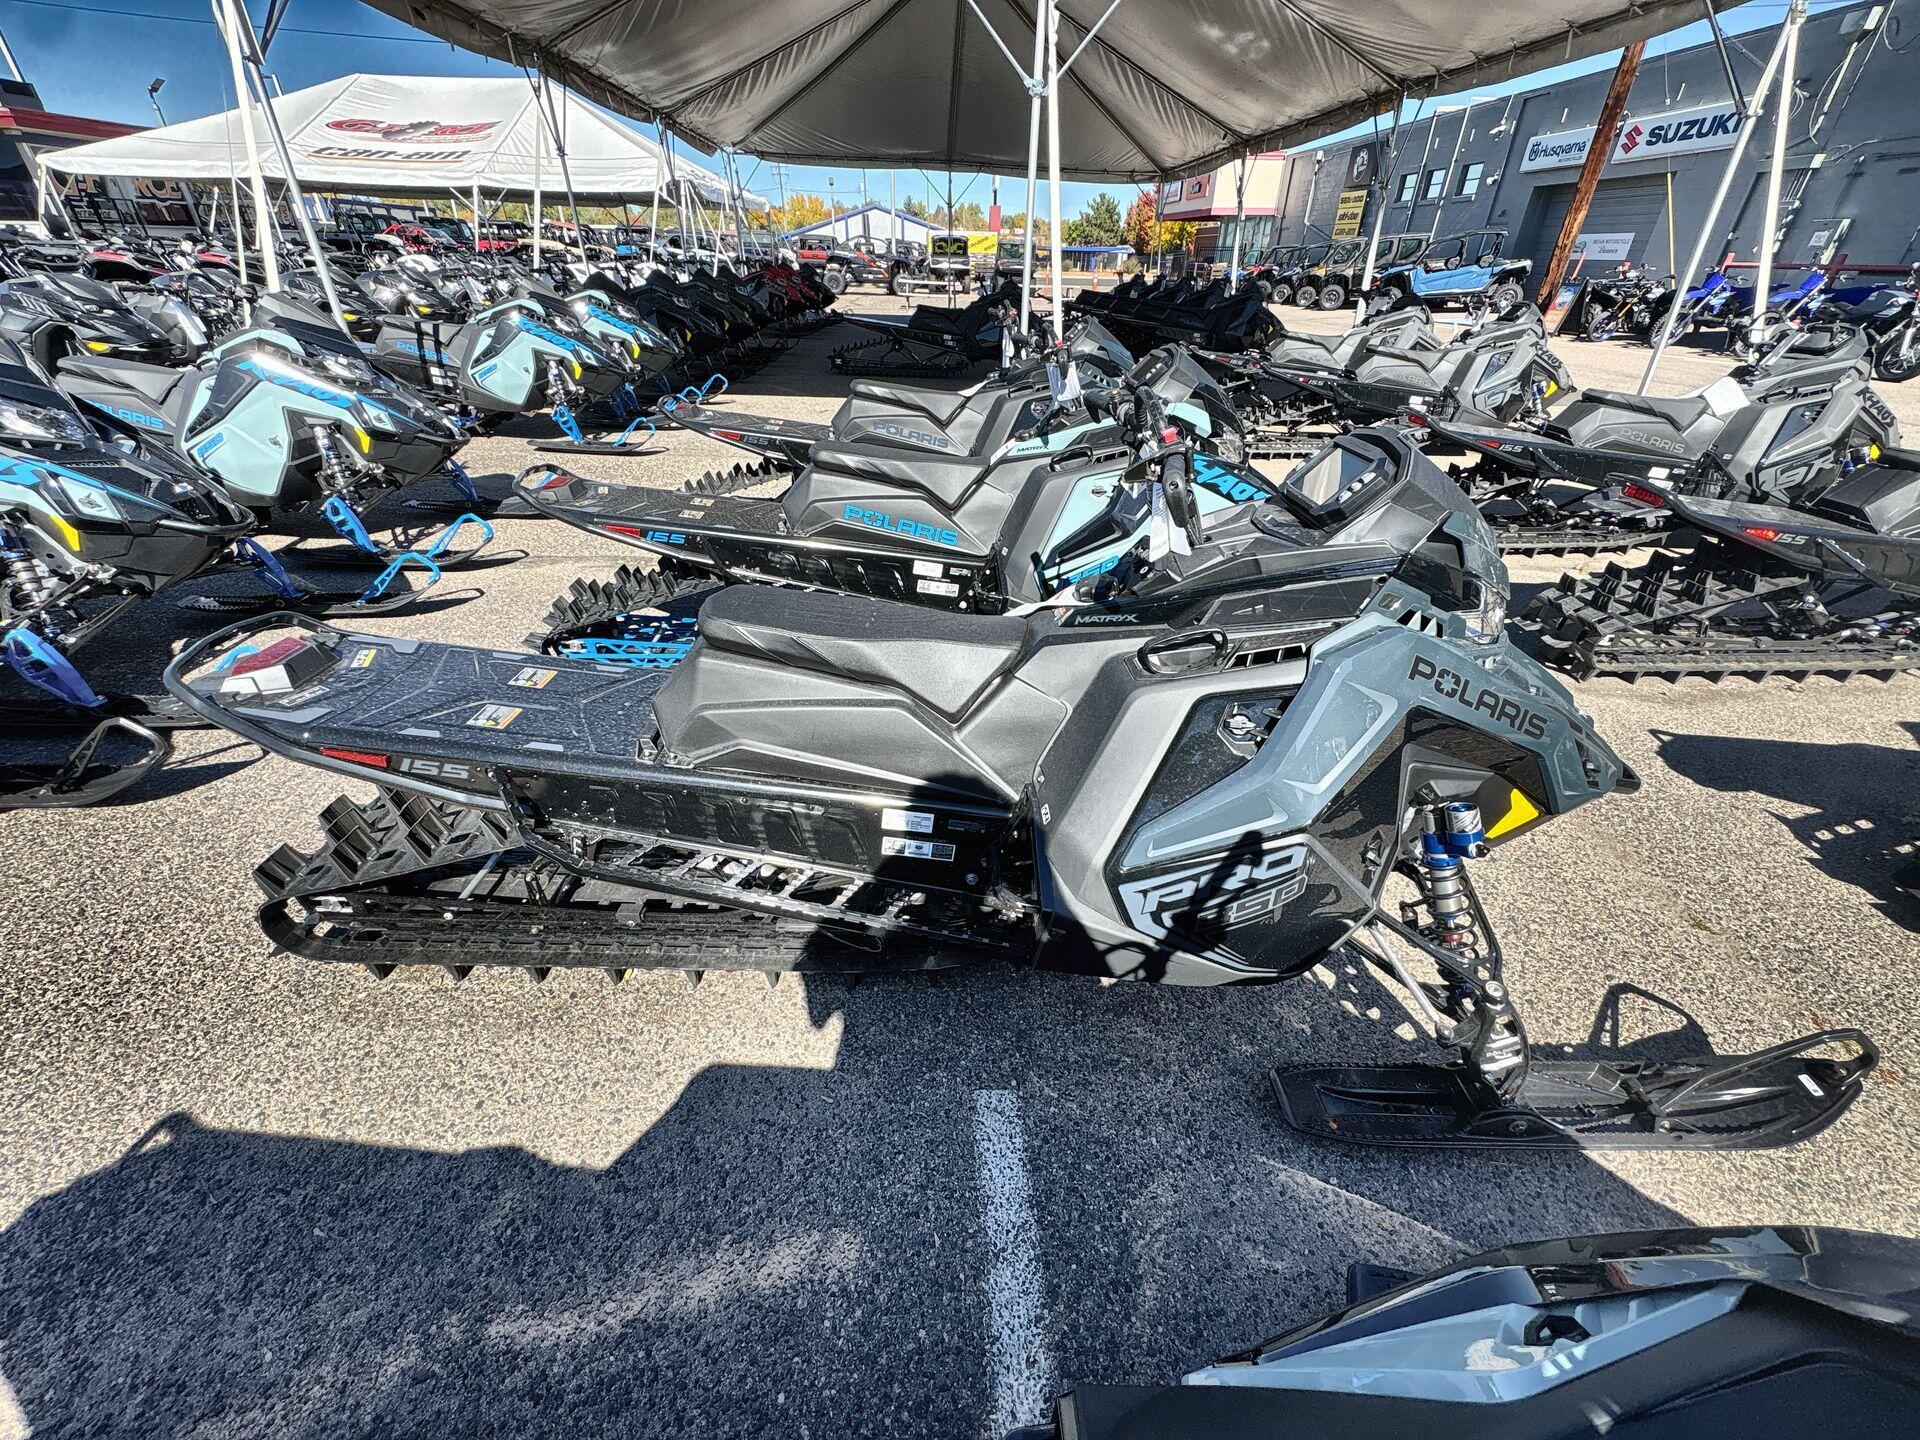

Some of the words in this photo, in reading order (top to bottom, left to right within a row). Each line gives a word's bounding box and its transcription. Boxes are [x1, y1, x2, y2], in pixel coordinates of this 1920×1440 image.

[1646, 112, 1743, 146] SUZUKI
[1538, 140, 1588, 158] Husqvarna
[396, 341, 449, 362] POLARS
[85, 400, 164, 429] LARIS
[1855, 386, 1897, 428] KHAOS
[740, 435, 769, 446] 155
[872, 420, 949, 450] POLARIS
[1619, 427, 1685, 454] POLARIS
[1499, 443, 1524, 452] 155
[844, 504, 959, 547] POLARIS
[646, 531, 687, 545] 155
[1773, 533, 1809, 545] 155
[1075, 613, 1140, 625] MATRYX
[1408, 654, 1549, 740] POLARIS
[400, 757, 471, 779] 155
